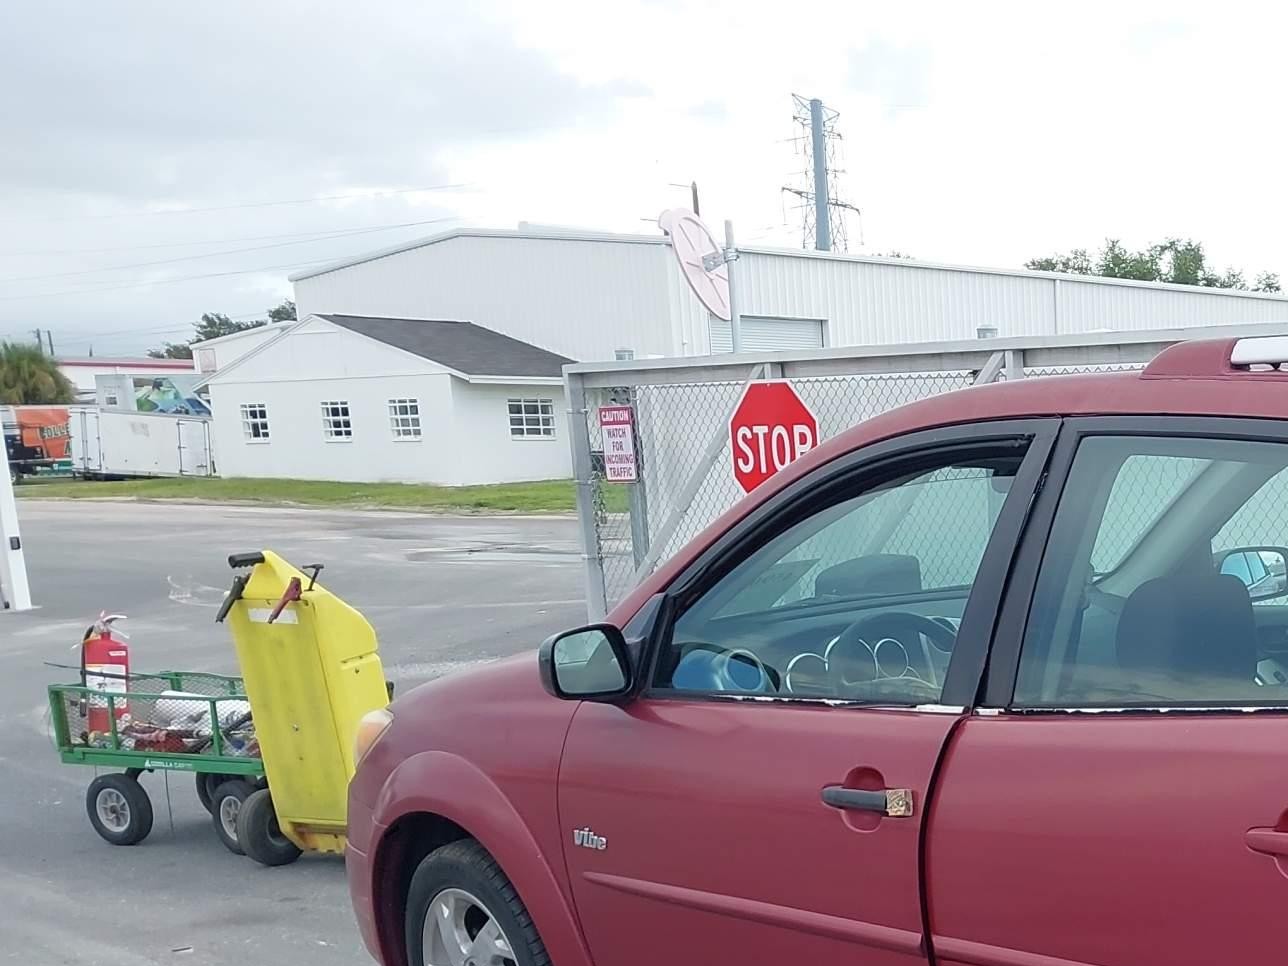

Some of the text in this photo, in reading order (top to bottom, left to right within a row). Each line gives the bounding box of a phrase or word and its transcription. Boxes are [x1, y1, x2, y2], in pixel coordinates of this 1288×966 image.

[601, 409, 629, 422] CAUTION
[607, 427, 627, 439] WATCH
[611, 441, 624, 452] FOR
[736, 424, 813, 474] STOP
[606, 454, 634, 465] INCOMING
[609, 466, 633, 478] TRAFFIC
[573, 827, 607, 850] vibe
